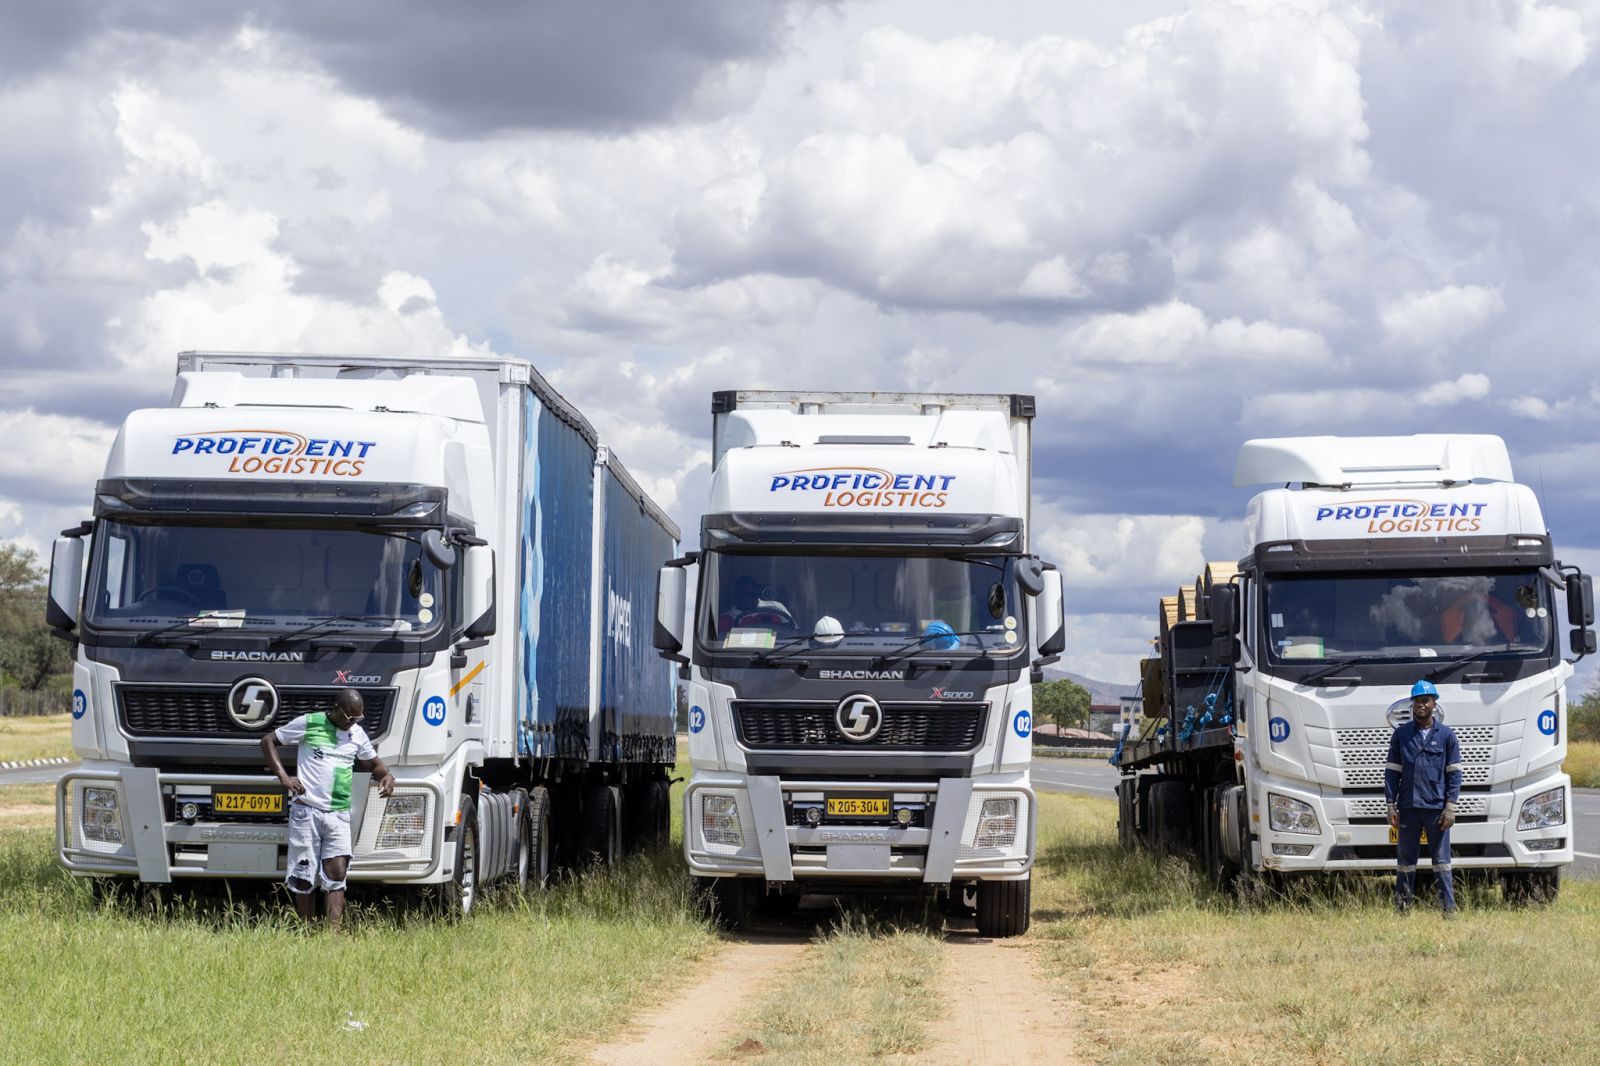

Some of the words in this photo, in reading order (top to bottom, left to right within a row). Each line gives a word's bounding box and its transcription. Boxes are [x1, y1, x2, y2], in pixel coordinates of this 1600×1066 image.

[228, 456, 365, 477] LOGISTICS
[823, 491, 948, 508] LOGISTICS
[1367, 518, 1482, 534] LOGISTICS
[210, 650, 303, 662] SHACMAN
[331, 669, 382, 684] X5000
[819, 670, 904, 680] SHACMAN
[928, 686, 974, 699] X5000
[72, 695, 84, 713] 03
[427, 702, 444, 720] 03
[690, 711, 702, 727] 02
[1017, 716, 1030, 732] 02
[1542, 715, 1555, 730] 01
[1271, 722, 1285, 737] 01
[216, 796, 223, 808] N
[226, 796, 271, 809] 217-099
[274, 797, 281, 809] W
[829, 802, 835, 813] N
[838, 801, 879, 813] 205-304
[882, 801, 888, 813] W
